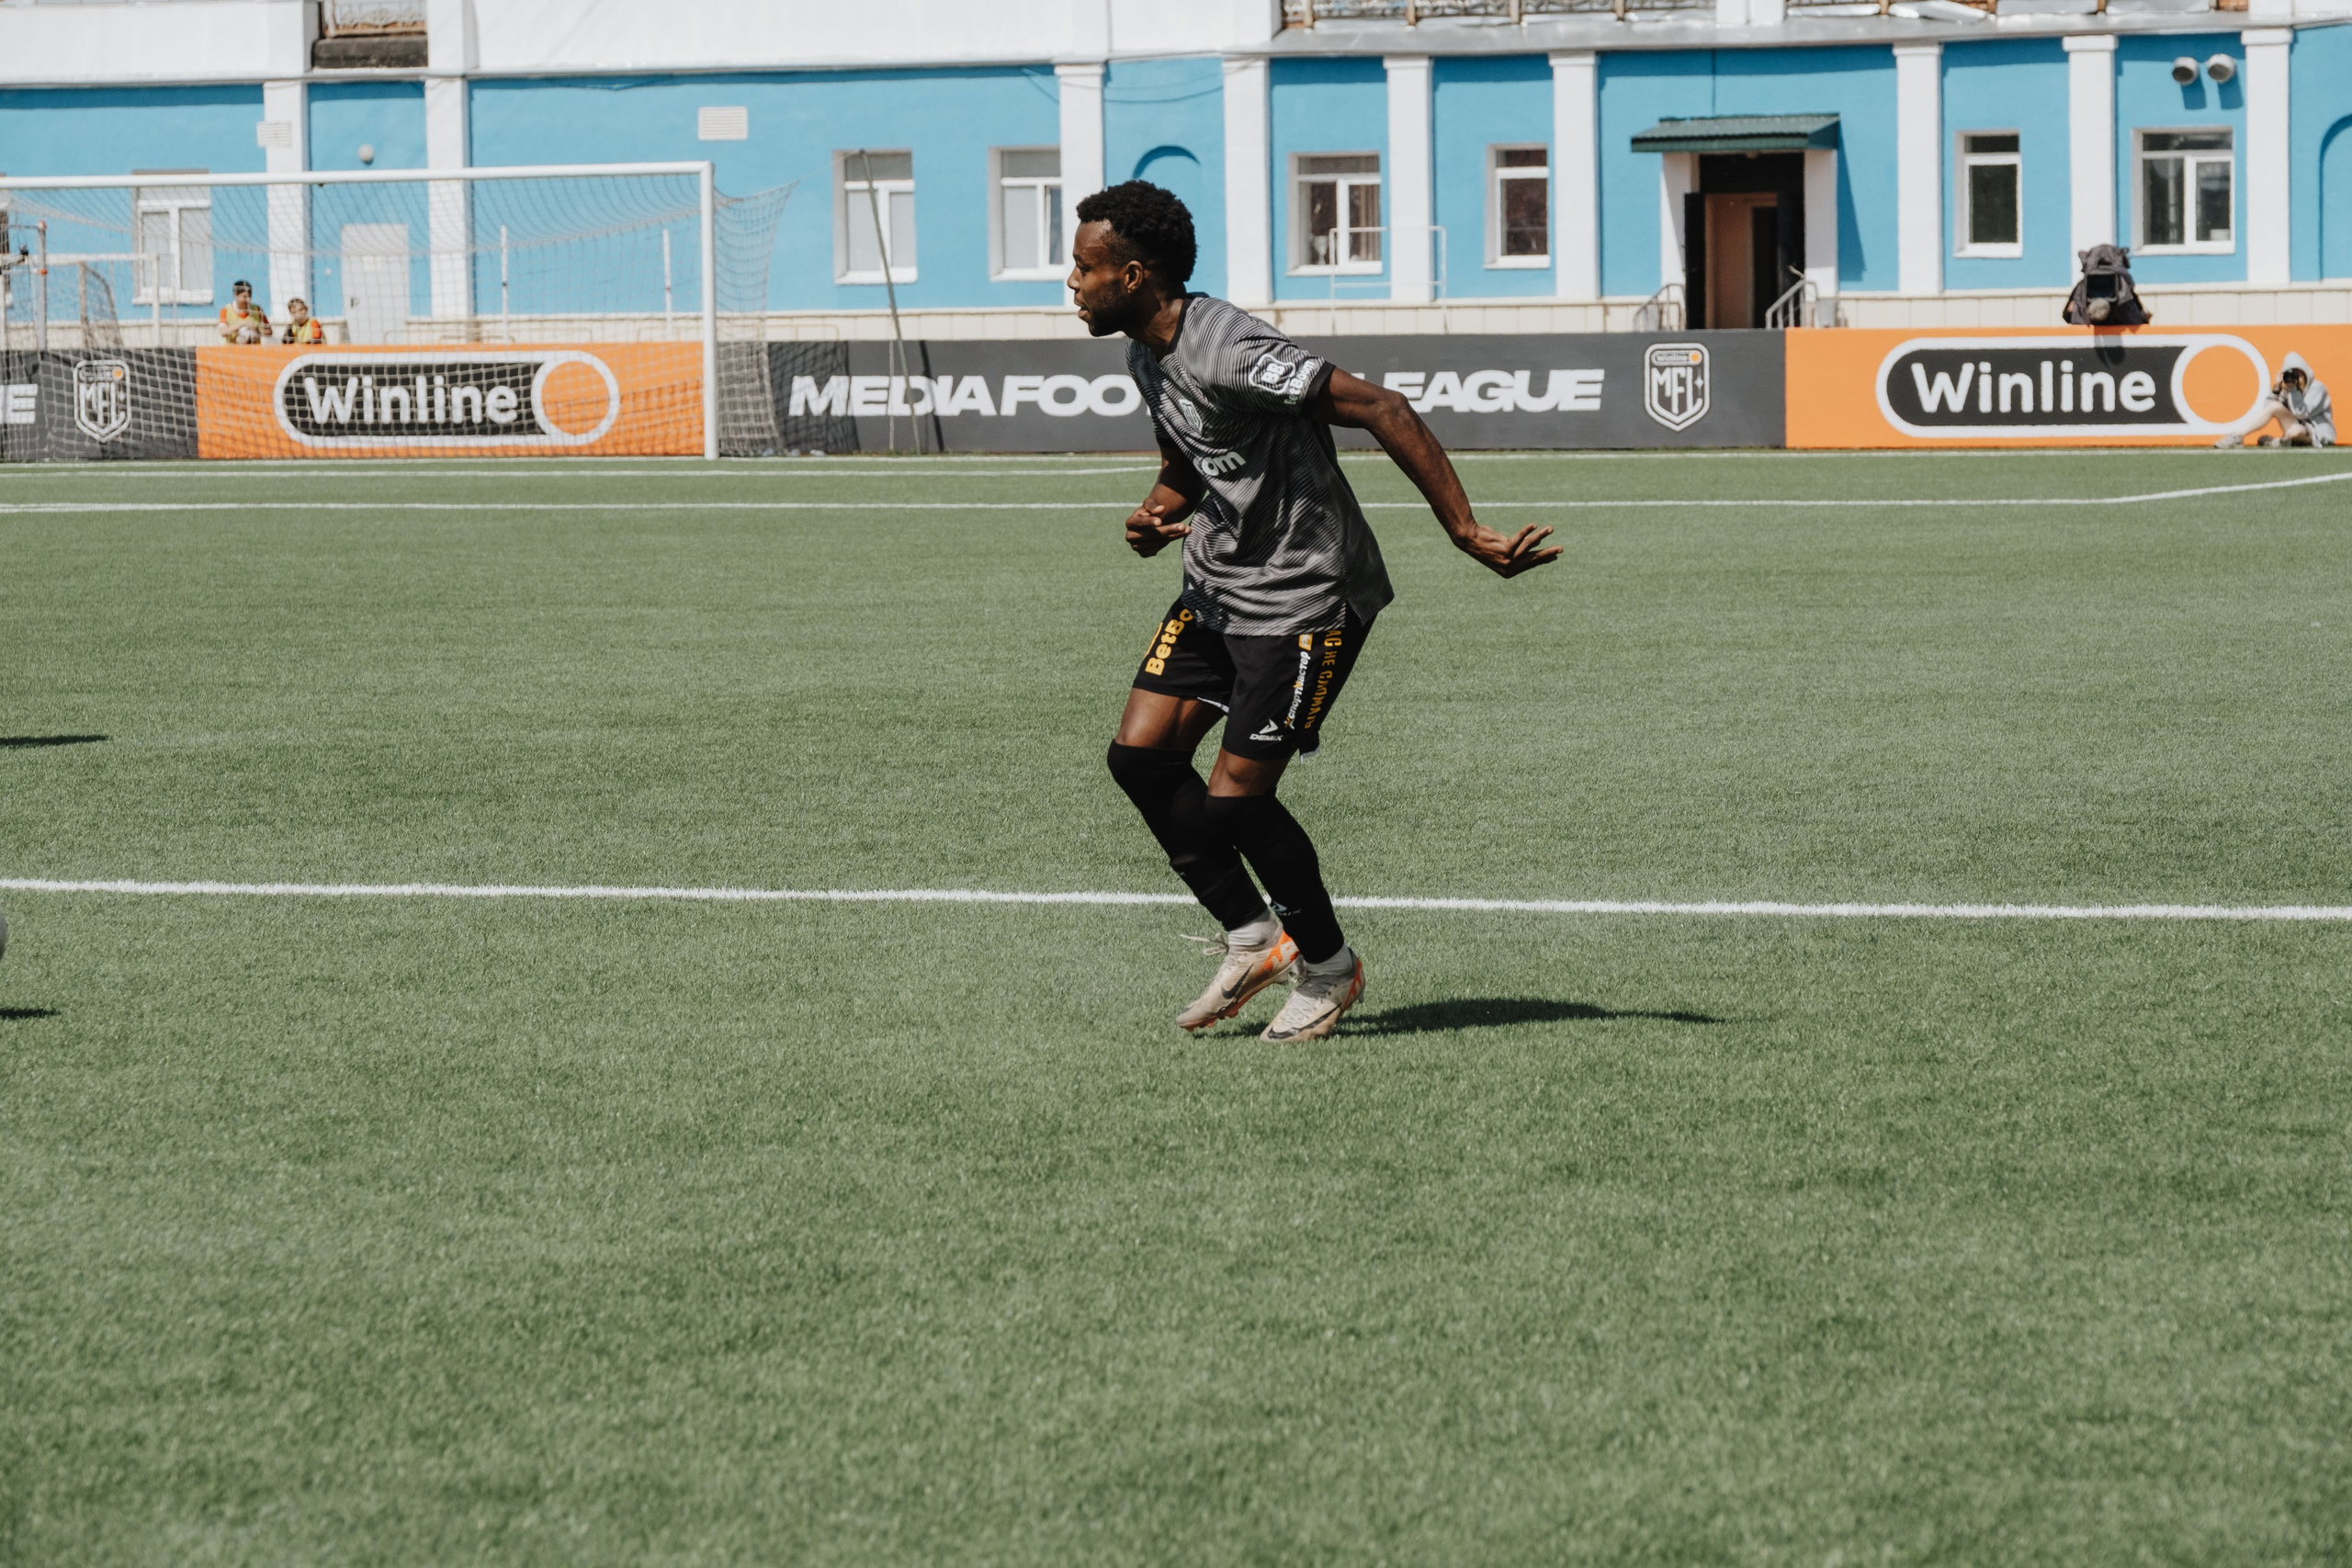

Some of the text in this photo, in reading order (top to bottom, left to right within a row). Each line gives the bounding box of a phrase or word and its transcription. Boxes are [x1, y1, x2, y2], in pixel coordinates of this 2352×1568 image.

[788, 375, 997, 417] MEDIA
[1351, 368, 1605, 413] EAGUE
[1261, 362, 1284, 385] BB
[1910, 359, 2156, 413] Winline
[303, 376, 518, 425] Winline
